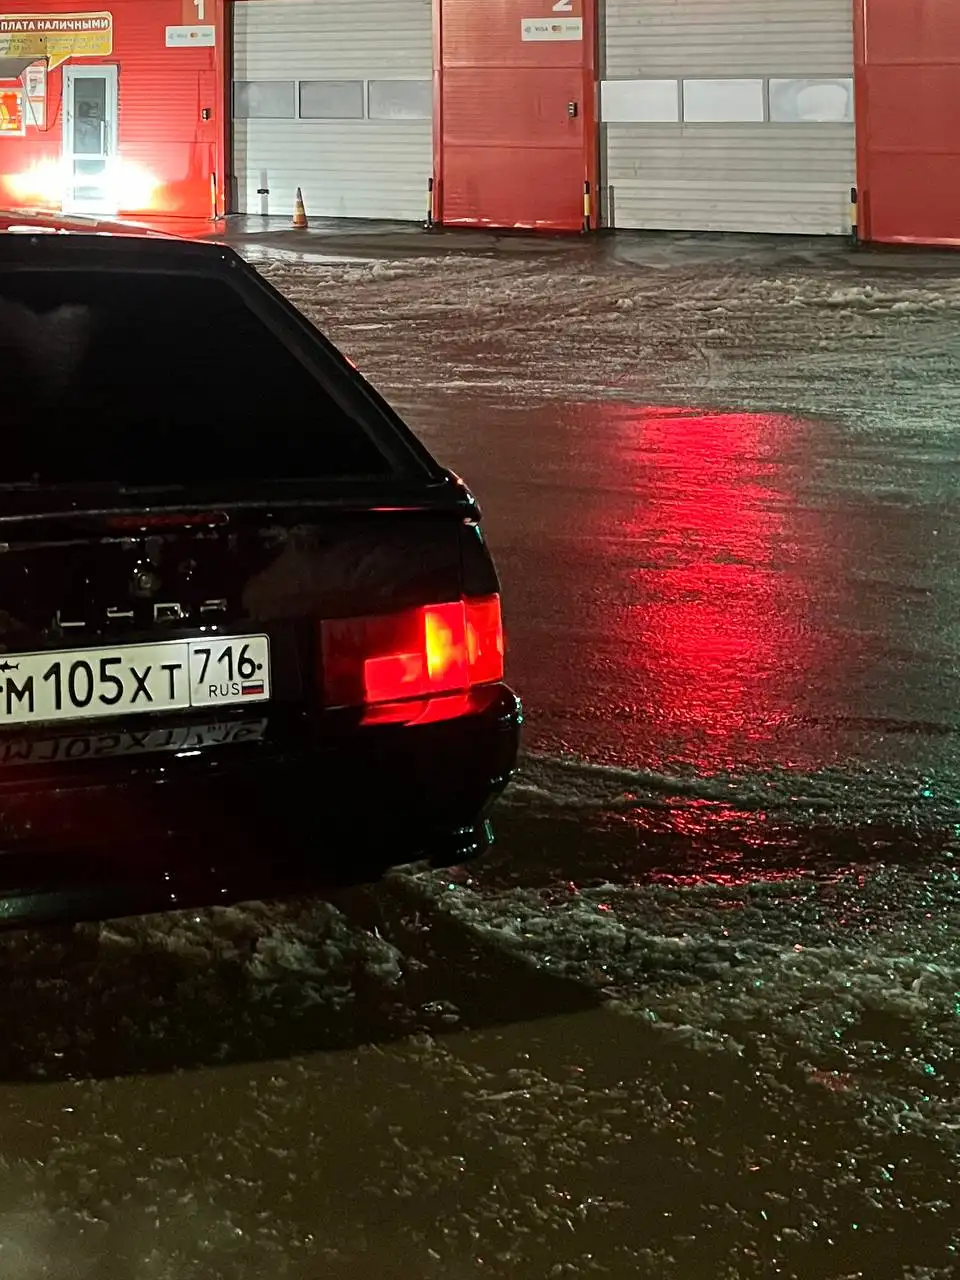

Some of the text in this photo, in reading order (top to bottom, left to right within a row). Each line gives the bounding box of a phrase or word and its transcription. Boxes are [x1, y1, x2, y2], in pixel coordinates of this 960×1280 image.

[37, 18, 108, 30] НАЛИЧНЫМИ
[193, 644, 256, 684] 716
[208, 682, 240, 697] RUS
